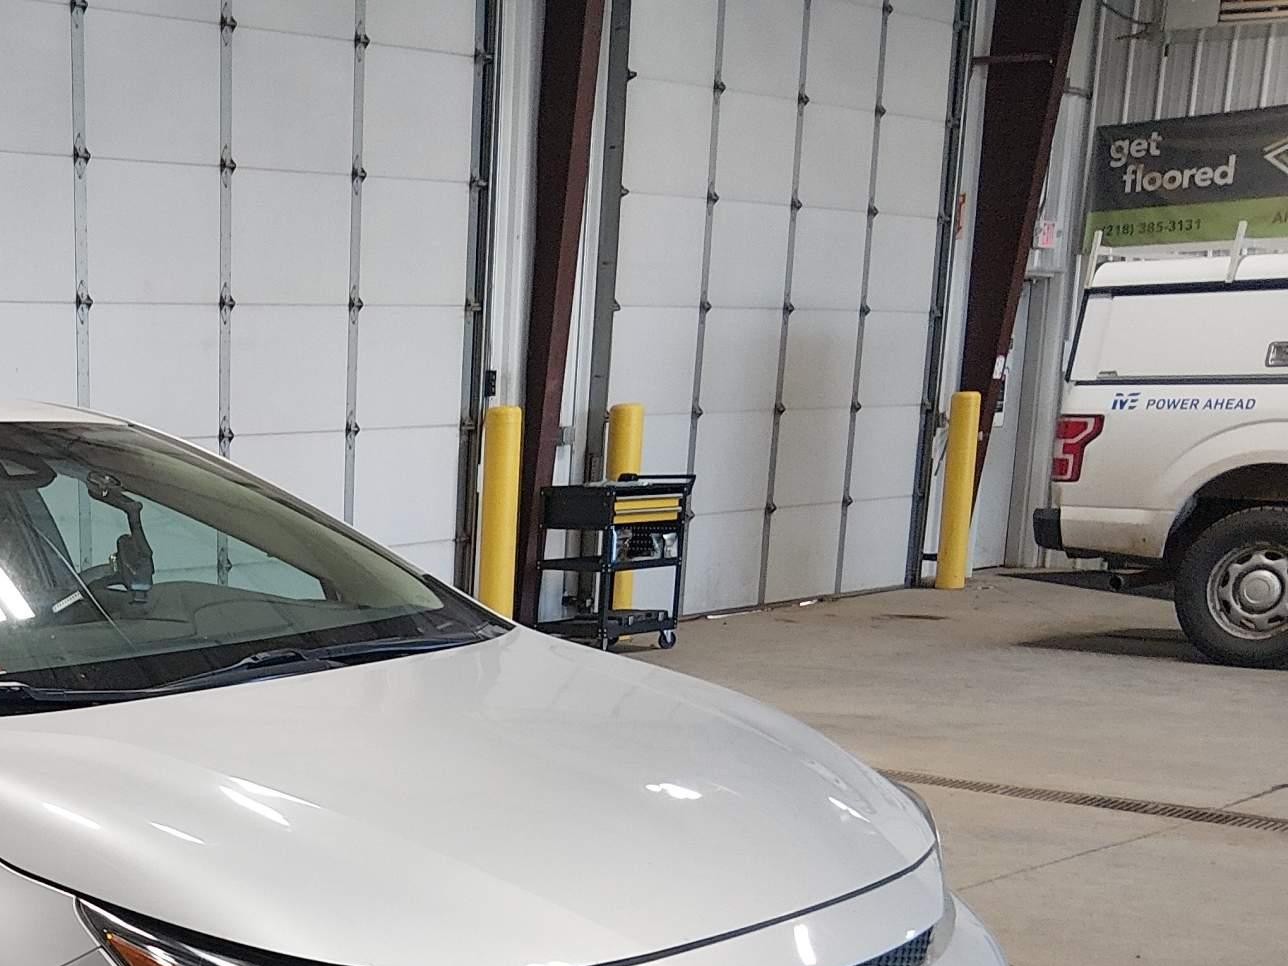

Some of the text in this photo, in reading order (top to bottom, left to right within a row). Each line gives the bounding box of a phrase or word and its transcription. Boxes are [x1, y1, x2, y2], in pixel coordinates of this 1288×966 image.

[1110, 131, 1162, 168] get
[1123, 154, 1237, 193] floored
[1138, 218, 1201, 235] 385-3131
[1146, 398, 1199, 411] POWER
[1202, 398, 1257, 411] AHEAD
